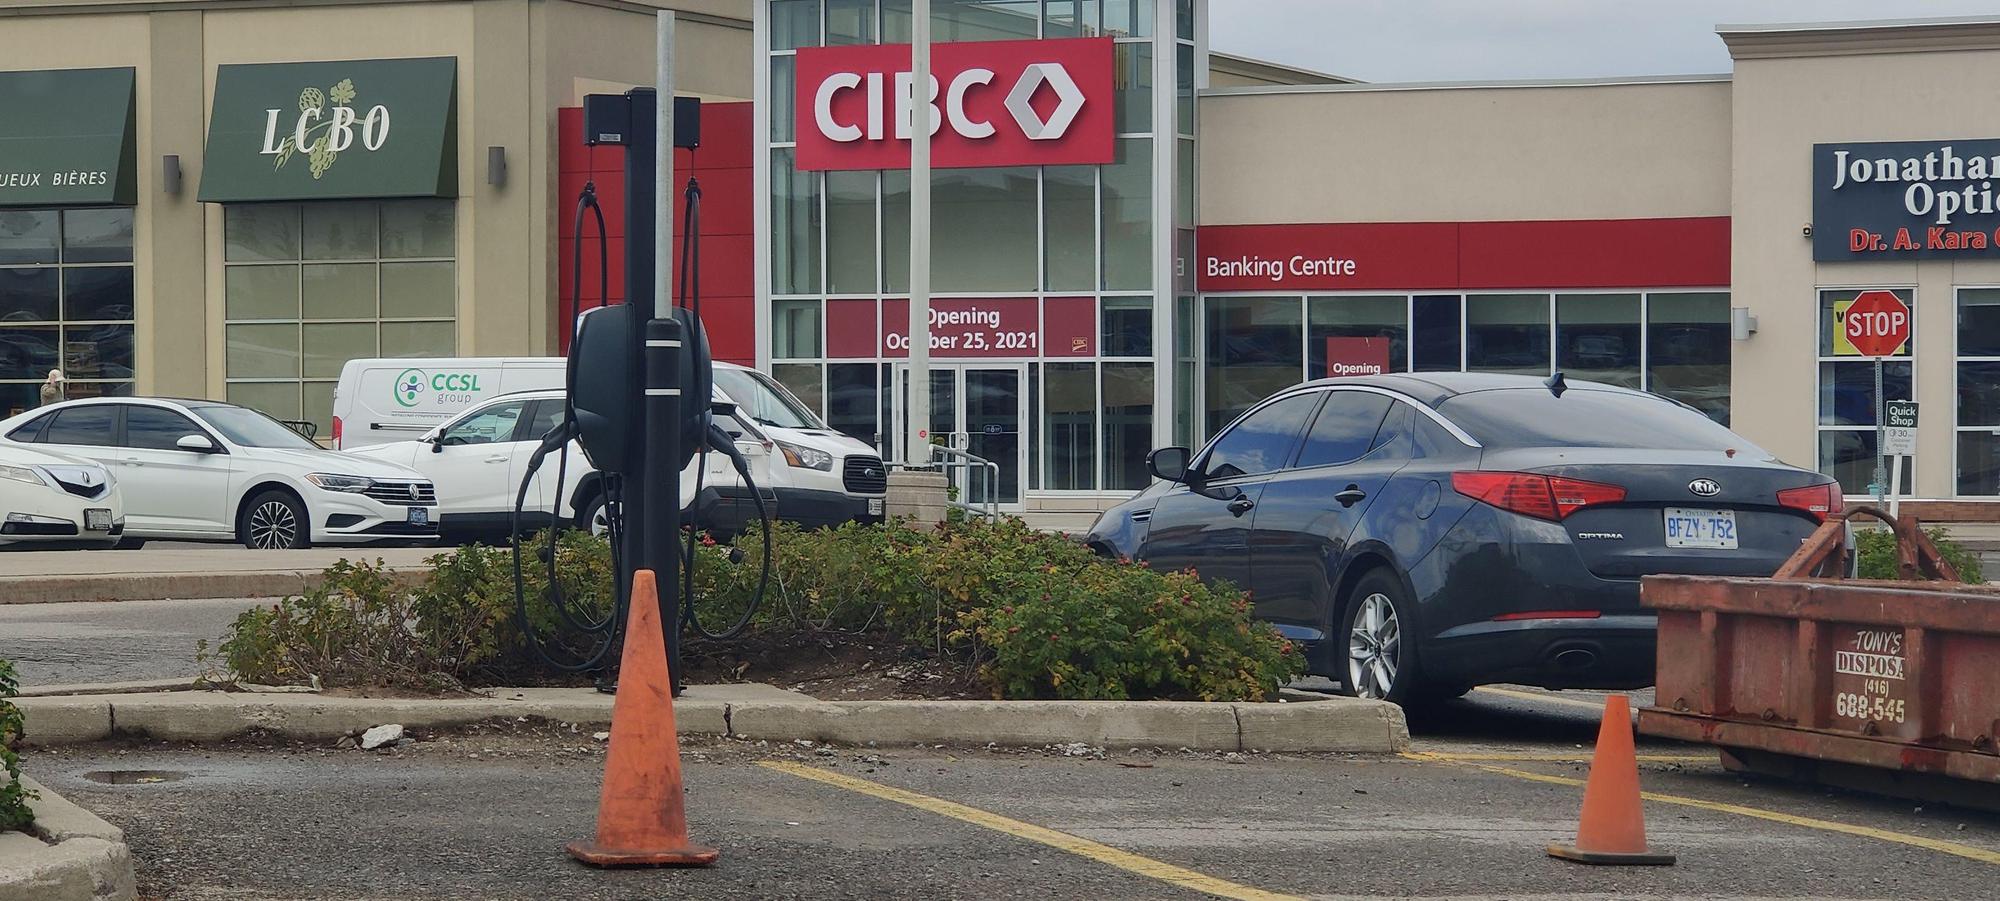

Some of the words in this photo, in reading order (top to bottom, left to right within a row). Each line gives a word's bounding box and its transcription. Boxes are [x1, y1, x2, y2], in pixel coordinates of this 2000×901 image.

[814, 68, 997, 142] CIBC
[259, 104, 391, 154] LCBO
[52, 169, 107, 186] BIÈRES
[1904, 181, 2000, 225] Opti
[1850, 228, 1888, 252] Dr.
[1893, 227, 1921, 250] A.
[1927, 226, 1987, 250] Kara
[1206, 255, 1284, 281] Banking
[1289, 255, 1356, 276] Centre
[1848, 311, 1906, 337] STOP
[886, 331, 959, 350] Ocber
[963, 332, 990, 351] 25,
[995, 331, 1036, 349] 2021
[1332, 362, 1381, 376] Opening
[431, 373, 481, 391] CCSL
[437, 393, 472, 405] group
[1889, 406, 1916, 416] Quick
[1890, 415, 1914, 427] Shop
[1668, 517, 1700, 538] BFZY
[1708, 518, 1734, 539] 752
[1855, 630, 1902, 655] TONY'S
[1864, 679, 1890, 698] (416)
